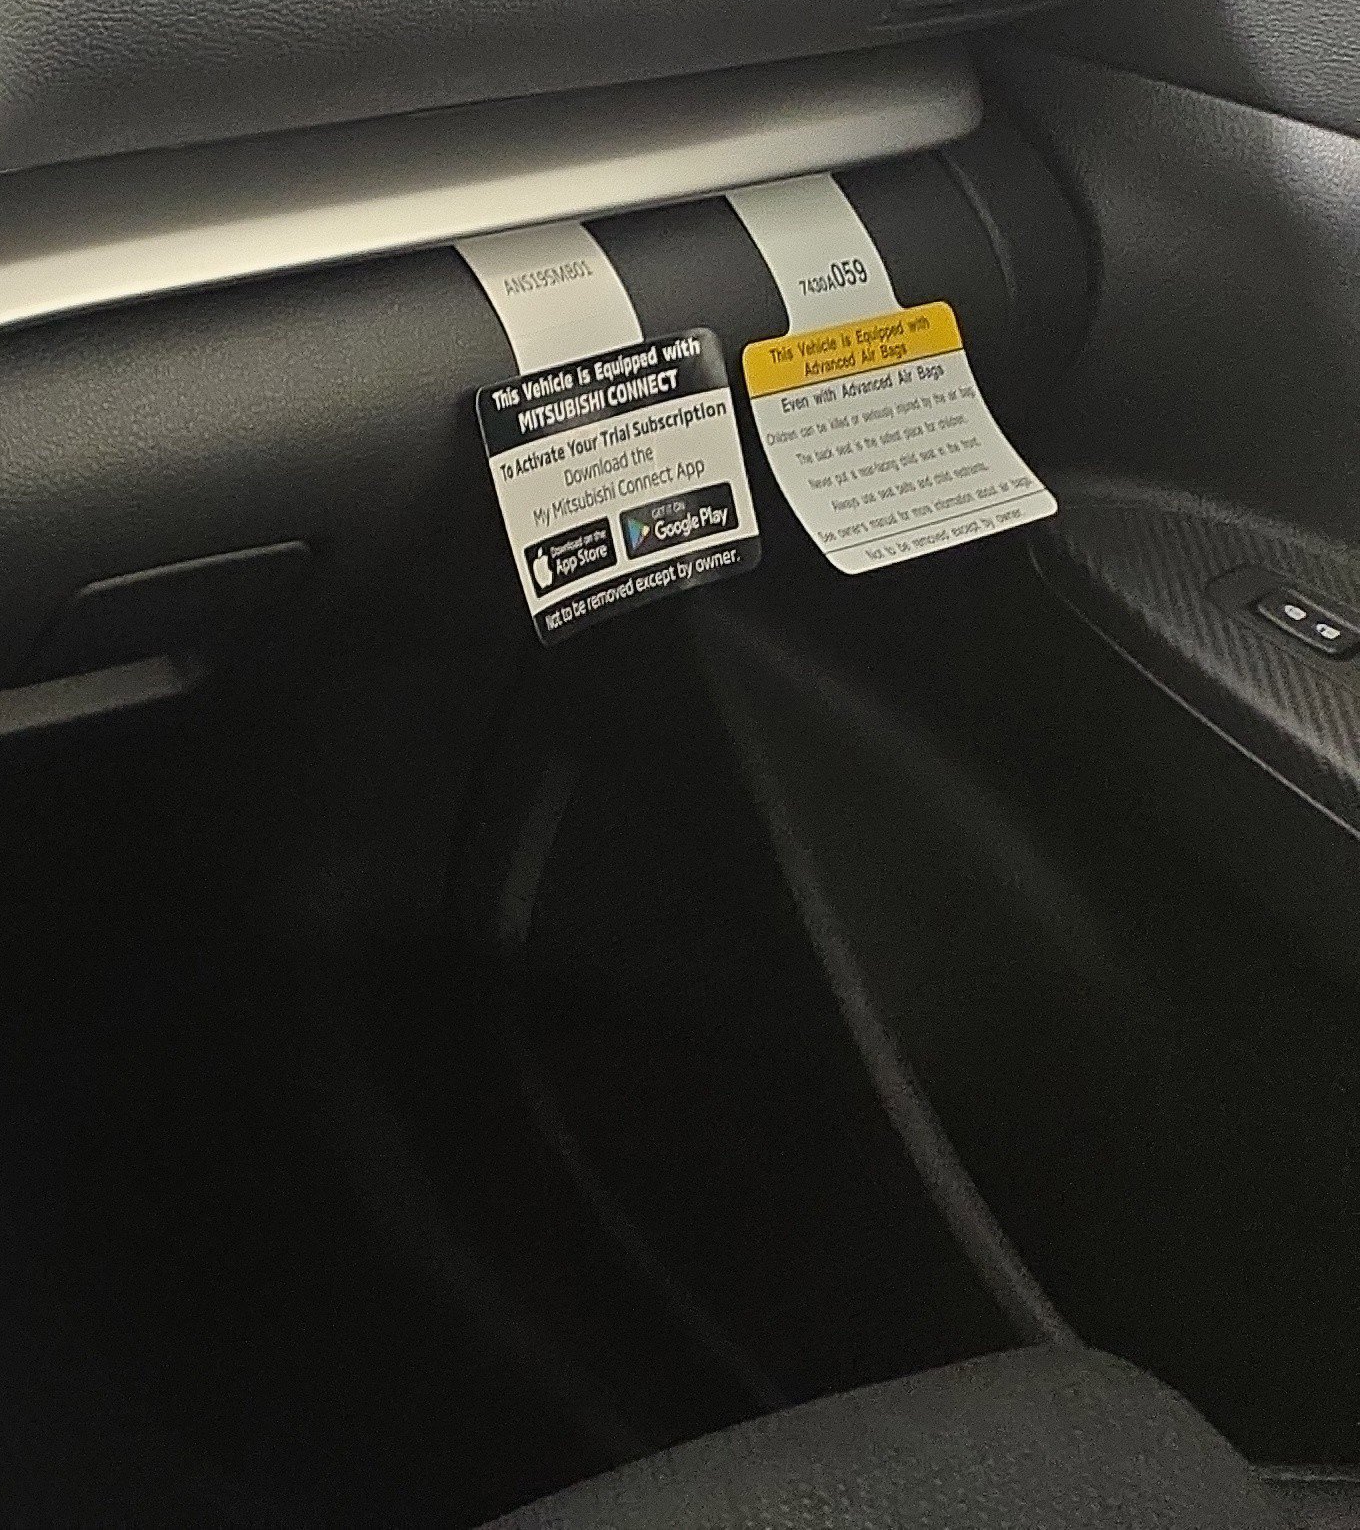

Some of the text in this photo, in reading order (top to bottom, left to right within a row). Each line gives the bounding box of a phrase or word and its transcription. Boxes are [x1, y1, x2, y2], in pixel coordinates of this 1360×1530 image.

[491, 387, 520, 411] This
[521, 371, 574, 401] Vehicle
[594, 345, 658, 382] Equipped
[662, 336, 701, 362] with
[518, 368, 679, 435] MITSUBISHI CONNECT
[499, 401, 727, 482] To Activate Your Trial Subscription
[564, 445, 654, 487] Download the
[533, 458, 705, 528] My Mitsubishi Connect App
[654, 506, 728, 540] Google Play
[556, 544, 608, 576] App Store
[587, 577, 634, 611] removed
[635, 565, 677, 592] except
[676, 561, 693, 579] by
[695, 549, 741, 573] owner.
